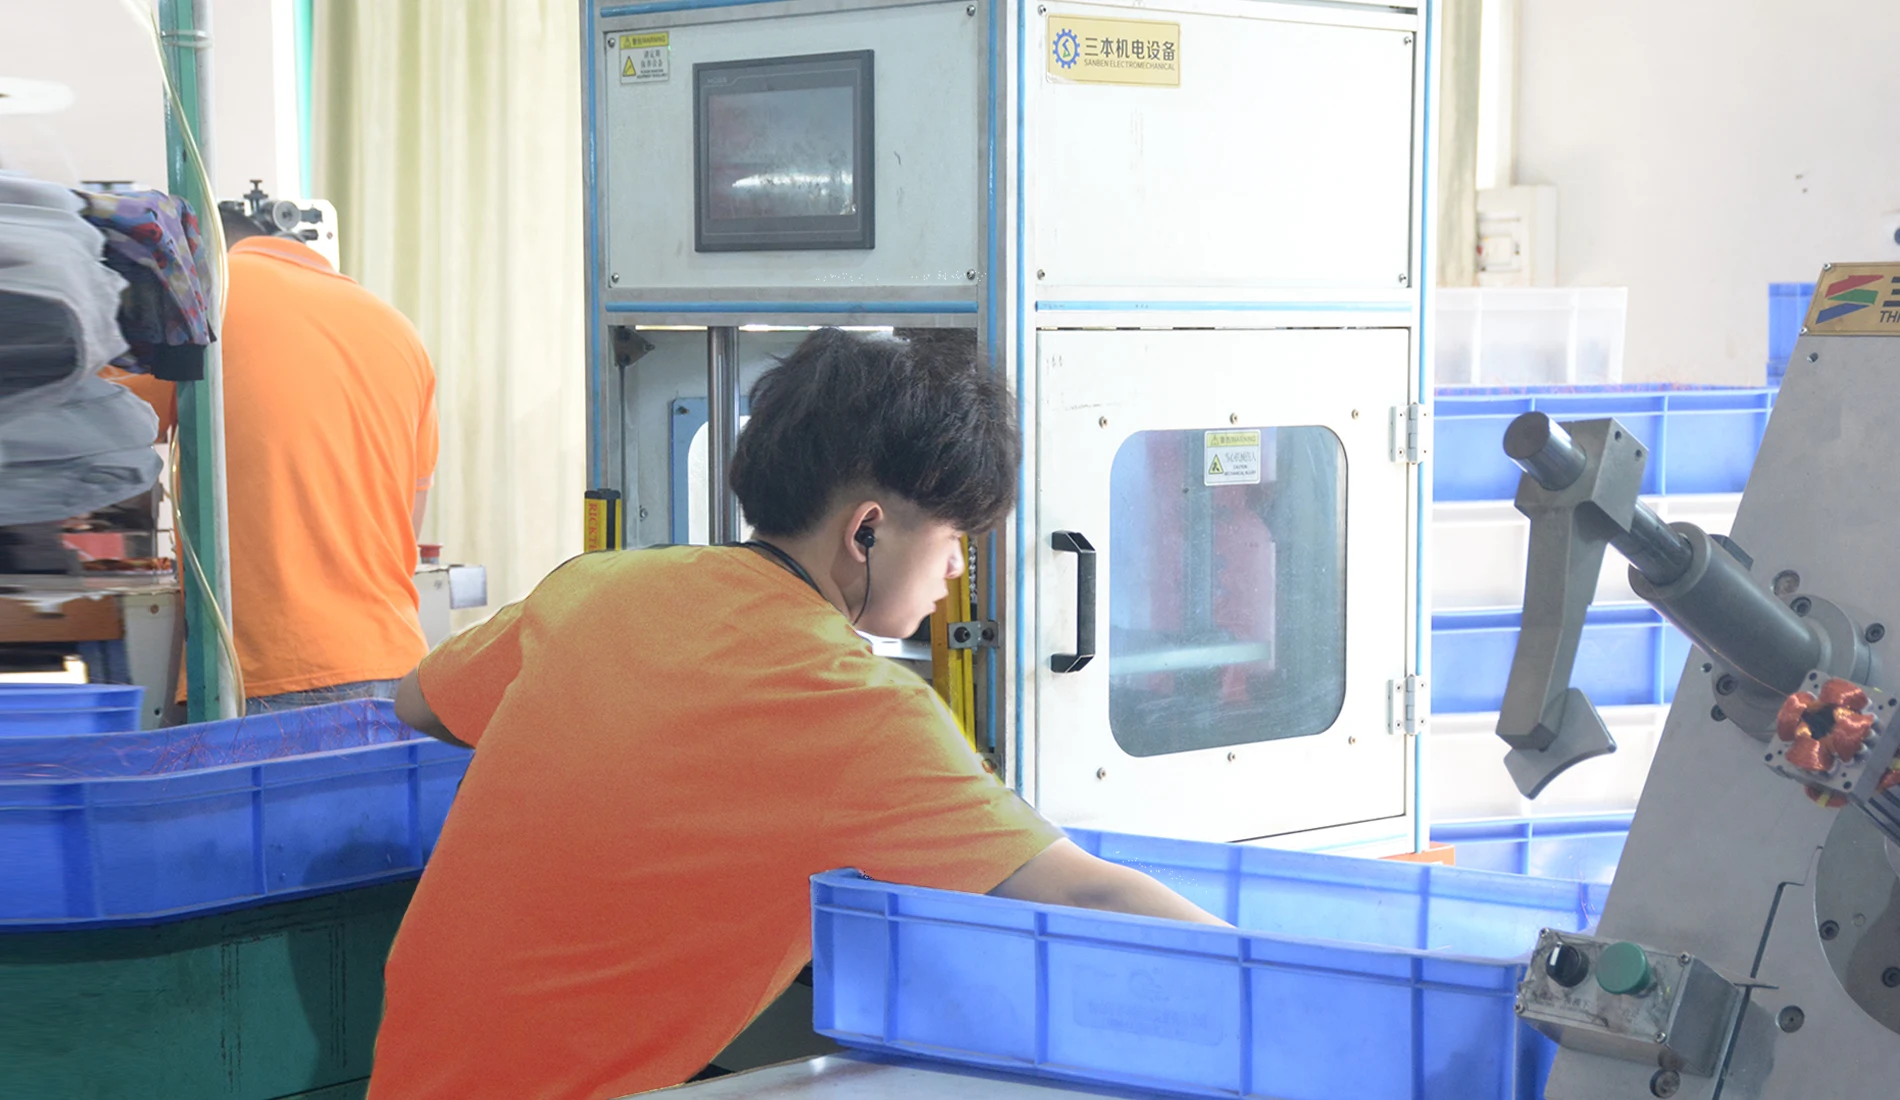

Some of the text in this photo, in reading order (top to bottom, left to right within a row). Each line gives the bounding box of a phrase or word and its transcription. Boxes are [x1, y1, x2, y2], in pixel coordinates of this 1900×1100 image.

[1084, 37, 1175, 61] 三本机电设备
[1084, 59, 1175, 71] SANBEN ELECTROMECHANICAL
